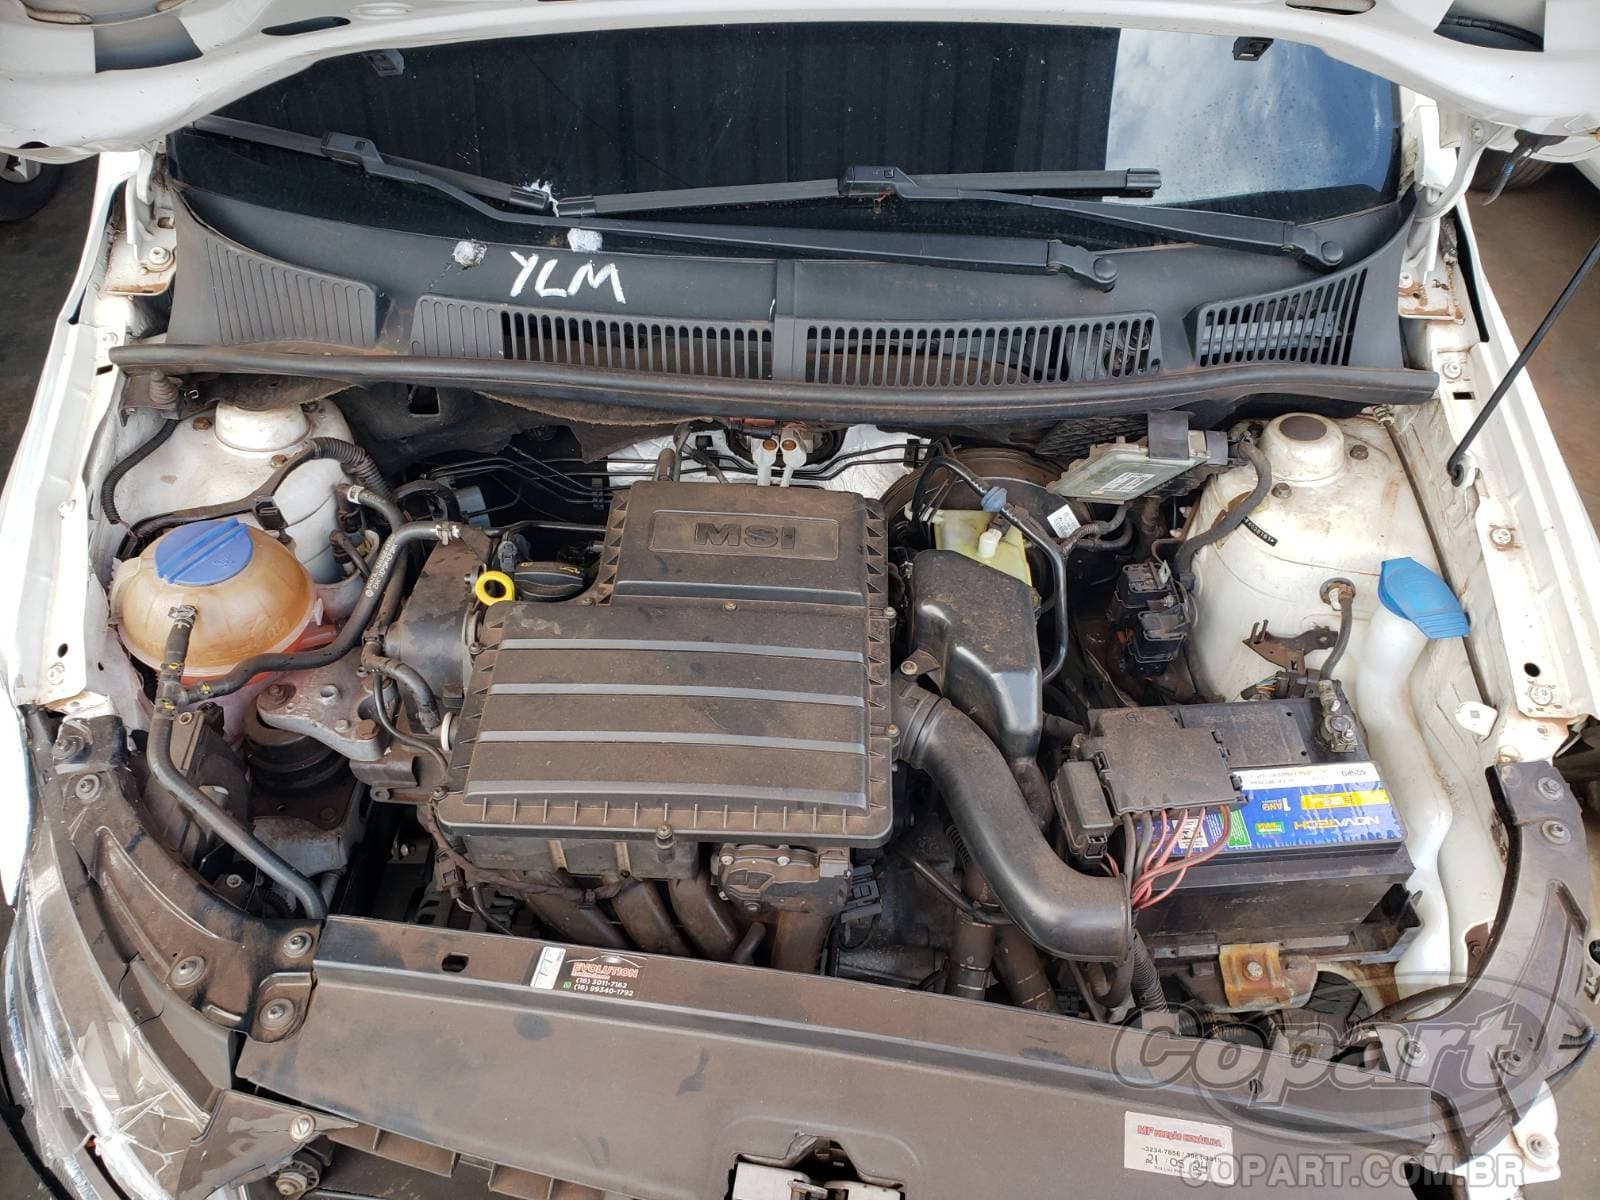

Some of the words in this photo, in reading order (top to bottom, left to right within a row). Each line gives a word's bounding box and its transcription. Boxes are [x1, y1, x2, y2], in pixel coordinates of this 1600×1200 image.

[510, 251, 626, 304] YLM
[695, 523, 796, 549] MSI
[1293, 815, 1380, 831] NOVATECH
[571, 962, 639, 978] EVOLUTION
[1137, 1125, 1154, 1136] MF
